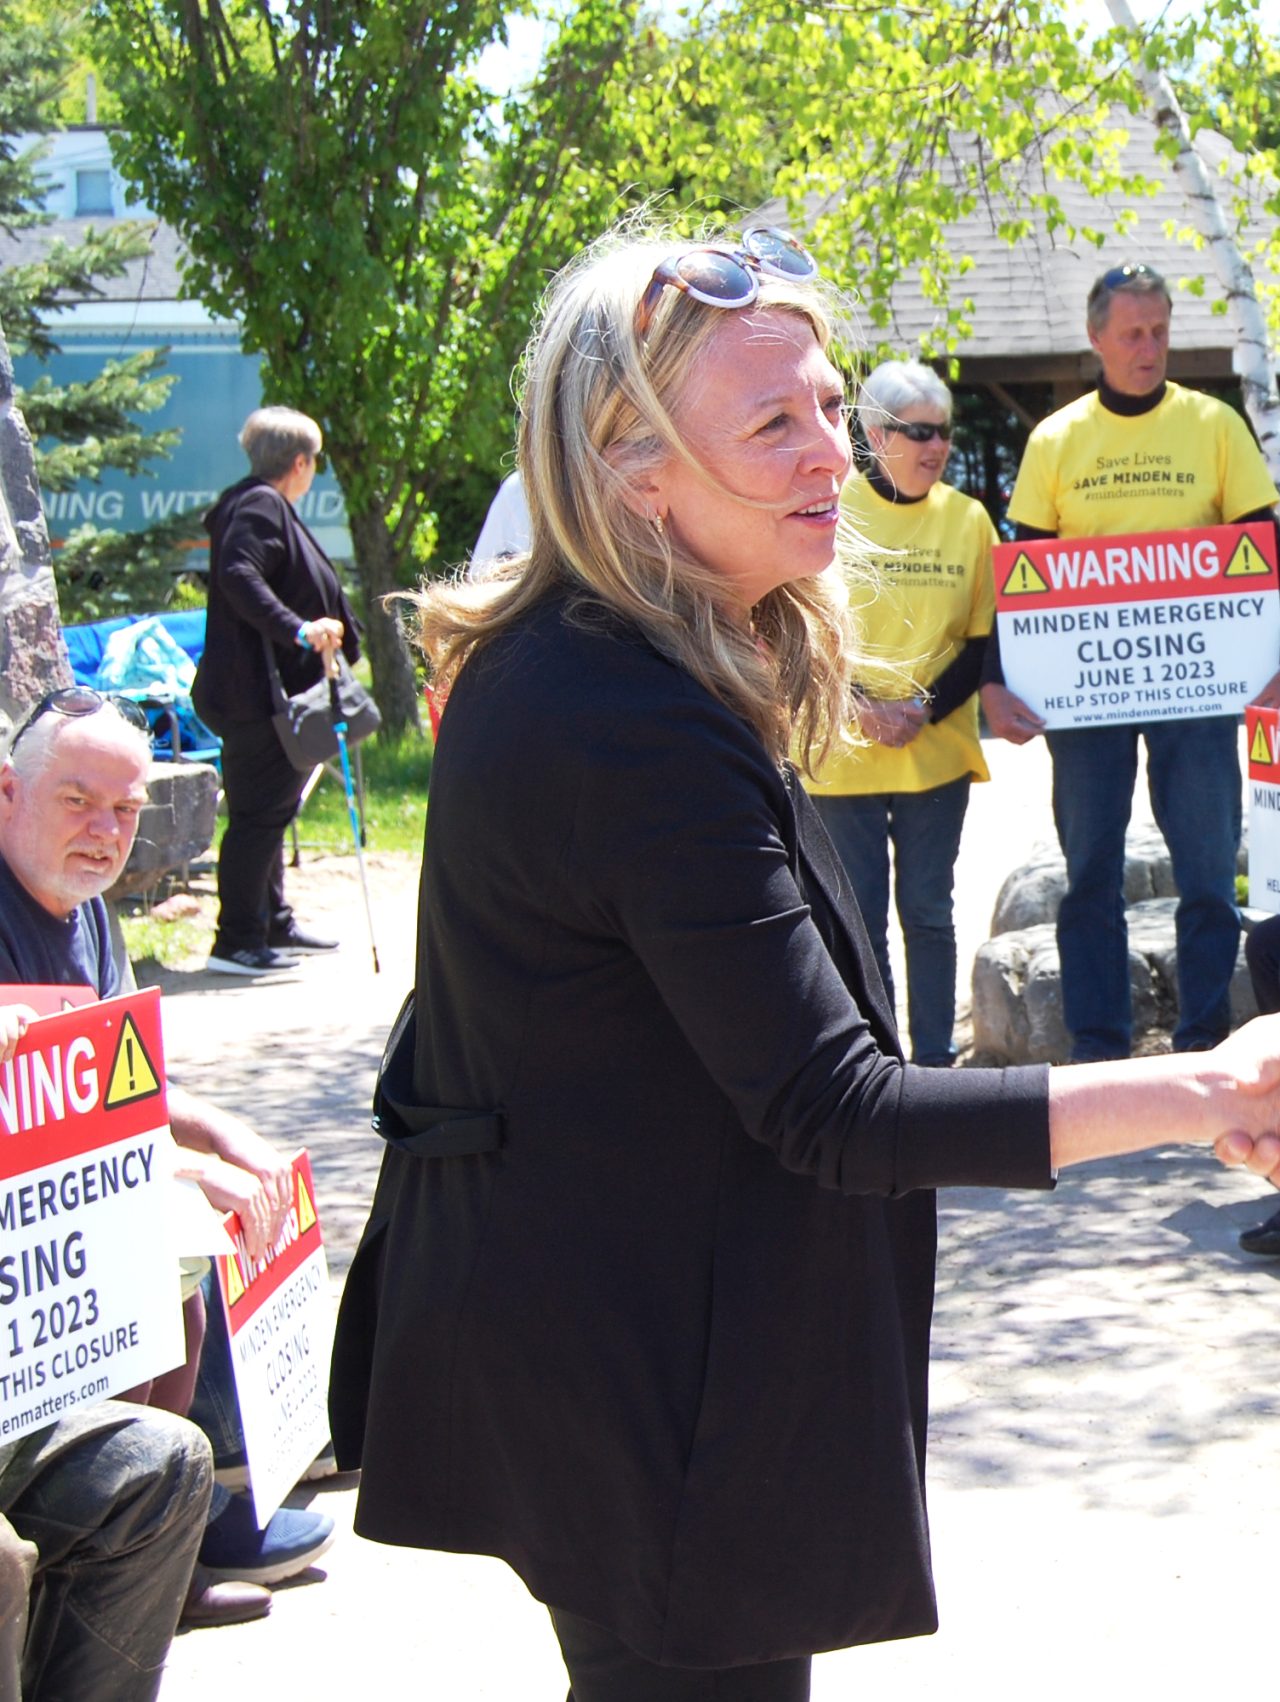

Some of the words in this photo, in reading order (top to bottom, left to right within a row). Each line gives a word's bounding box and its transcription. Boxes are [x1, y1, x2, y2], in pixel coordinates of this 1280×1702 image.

[1097, 456, 1129, 470] Save
[1134, 452, 1172, 466] Lives
[1113, 470, 1172, 485] MINDEN
[1176, 472, 1196, 484] ER
[1084, 487, 1185, 501] #mindenmatters
[947, 564, 966, 577] ER
[1045, 540, 1220, 590] WARNING
[1012, 609, 1109, 636] MINDEN
[1118, 597, 1265, 627] EMERGENCY
[1077, 632, 1206, 663] CLOSING
[1074, 666, 1135, 689] JUNE
[1142, 665, 1155, 683] 1
[1161, 660, 1216, 681] 2023
[1045, 691, 1085, 709] HELP
[1089, 689, 1131, 706] STOP
[1134, 685, 1172, 702] THIS
[1175, 680, 1248, 699] CLOSURE
[1073, 702, 1223, 723] www.mindenmatters.com
[0, 1231, 87, 1305] SING
[8, 1318, 23, 1358] 1
[31, 1288, 100, 1348] 2023
[0, 1361, 46, 1401] THIS
[52, 1321, 139, 1379] CLOSURE
[0, 1375, 110, 1436] enmatters.com
